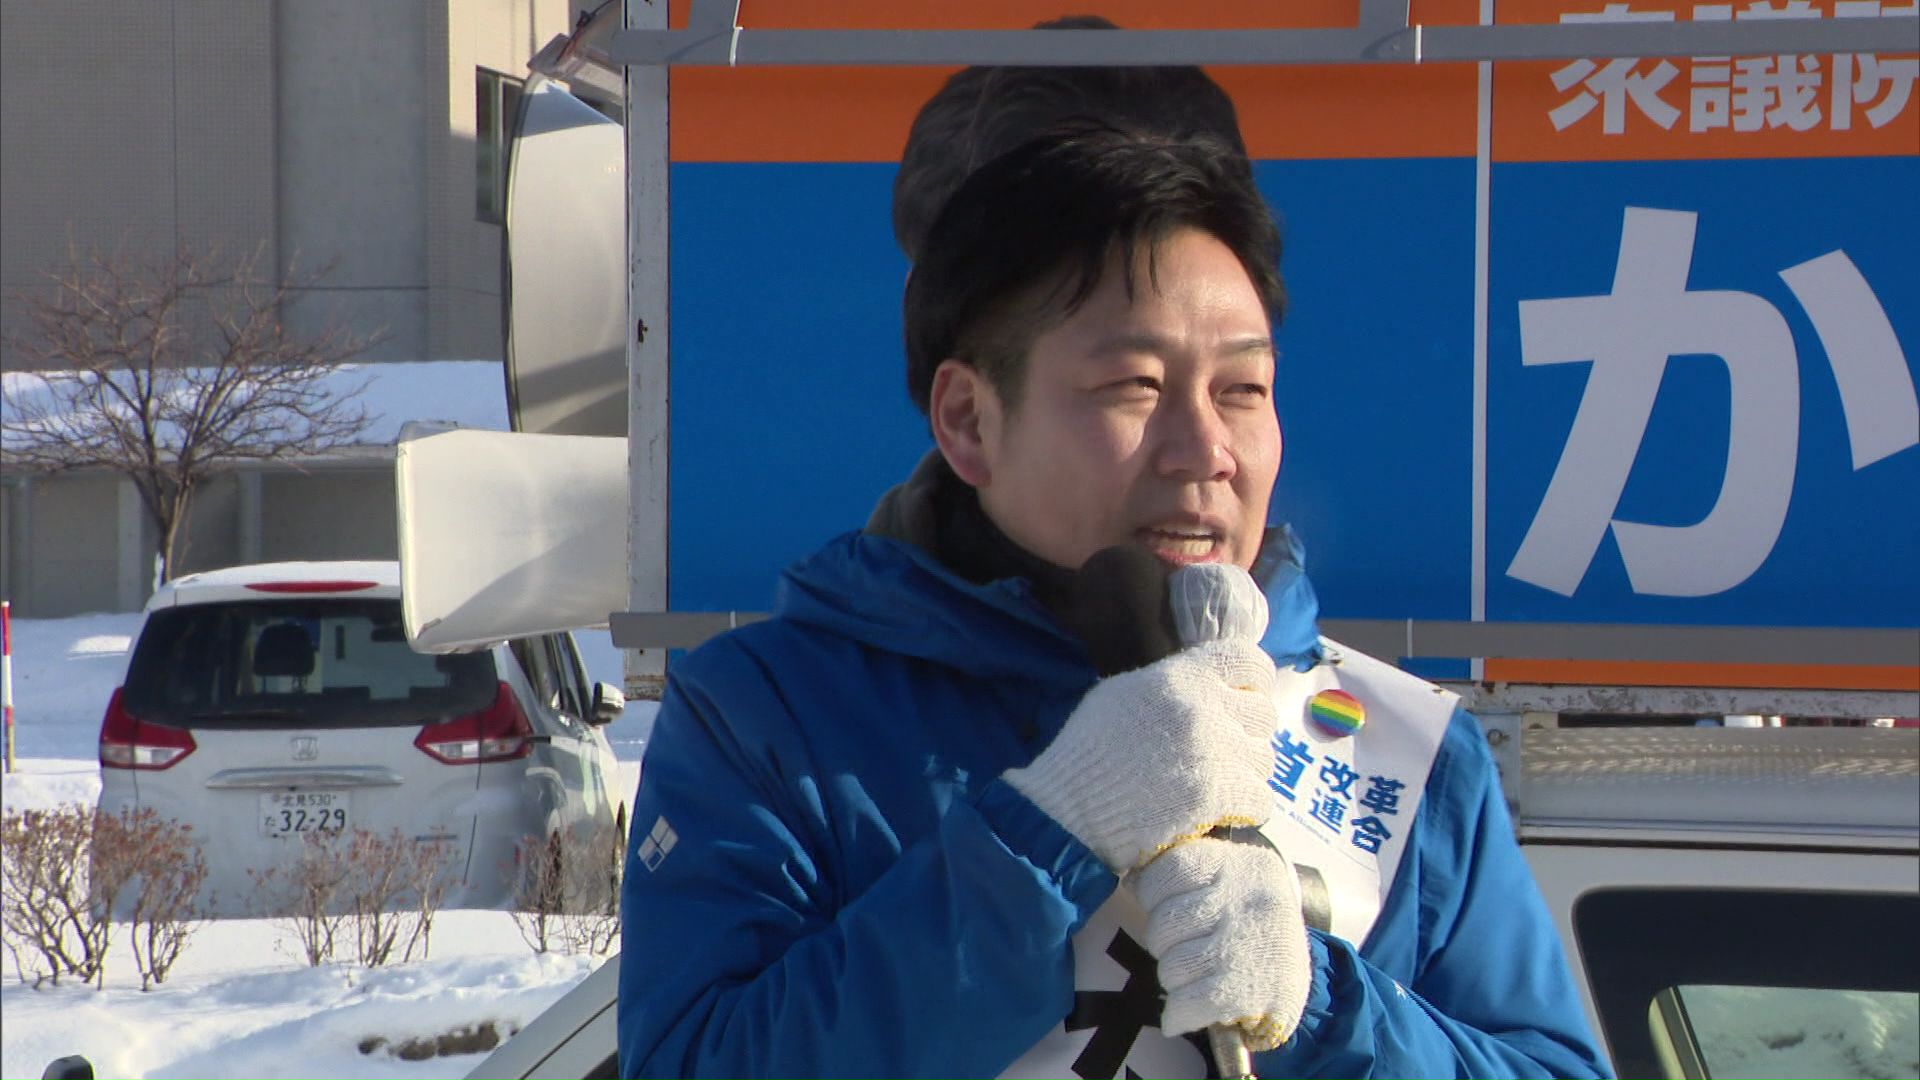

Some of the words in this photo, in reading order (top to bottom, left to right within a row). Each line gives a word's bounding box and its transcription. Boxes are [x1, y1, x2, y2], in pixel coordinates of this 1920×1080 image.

[1506, 206, 1919, 597] か
[1319, 755, 1406, 815] 改革
[280, 808, 345, 832] 32-29
[1309, 788, 1392, 855] 連合
